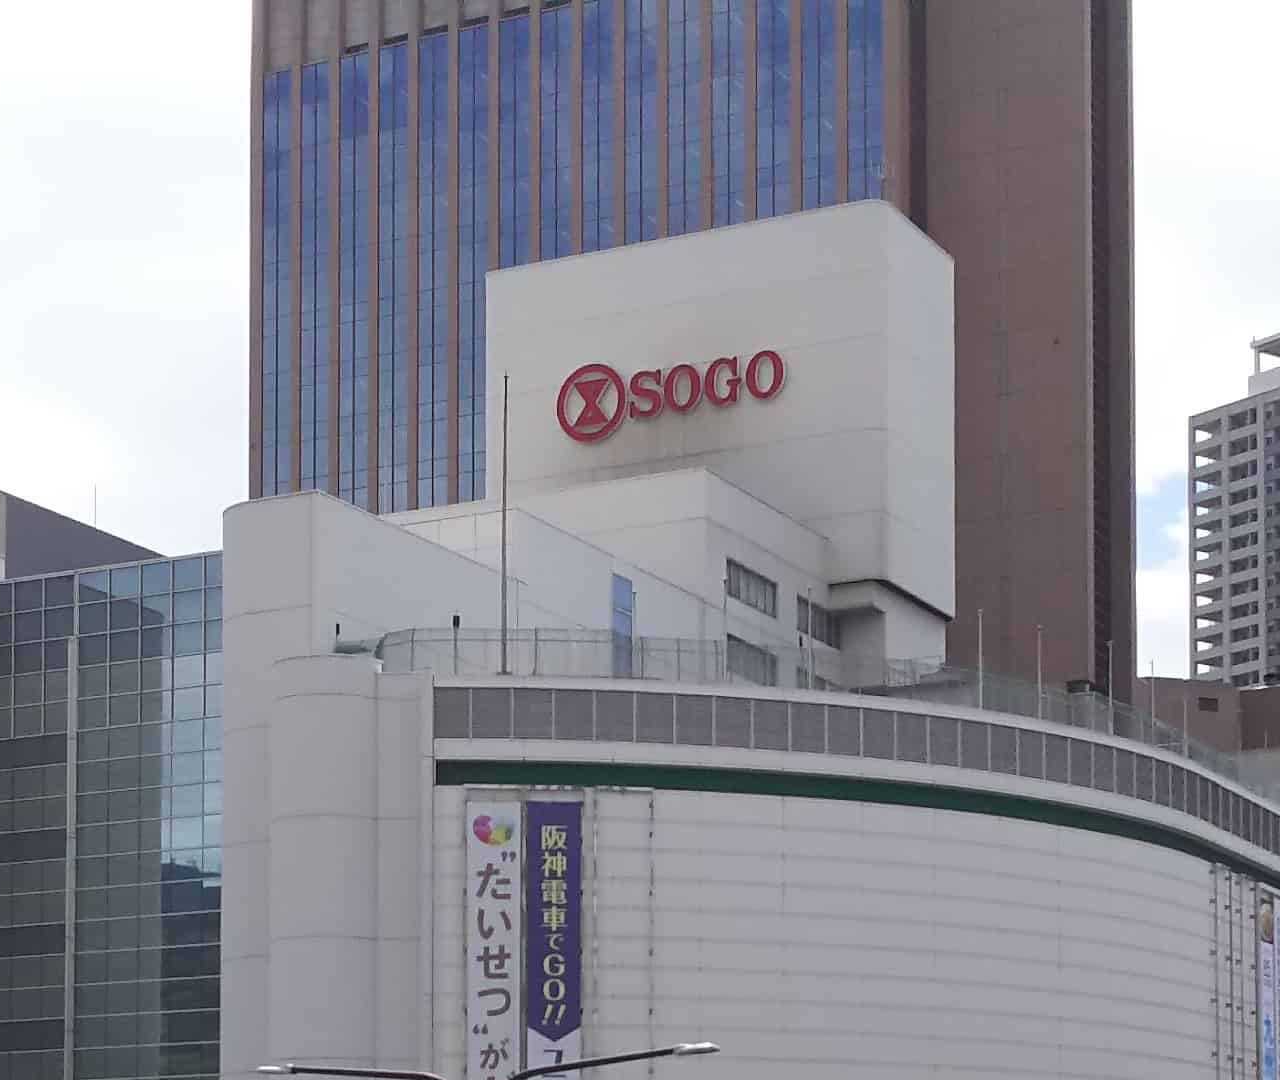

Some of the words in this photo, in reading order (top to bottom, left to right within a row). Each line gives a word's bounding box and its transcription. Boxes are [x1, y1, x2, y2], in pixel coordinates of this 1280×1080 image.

[629, 350, 785, 420] SOGO
[540, 824, 569, 1026] 阪神電車でGO!!
